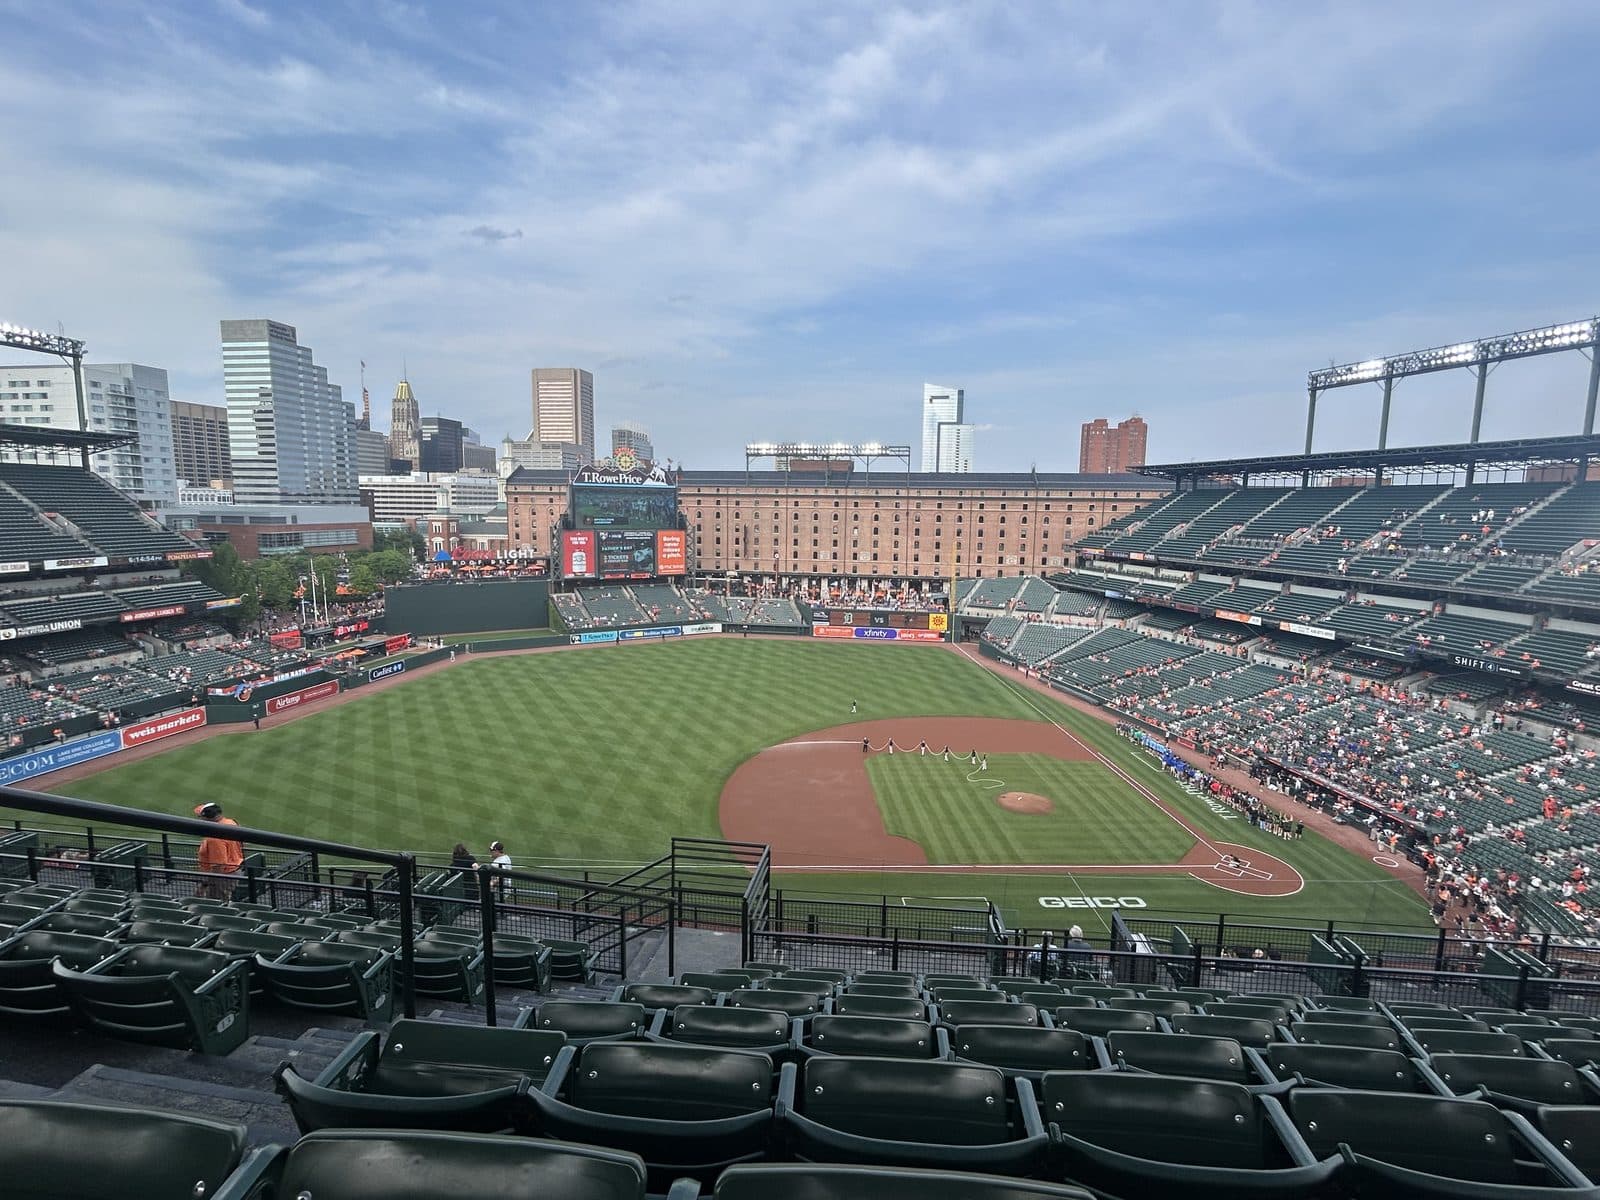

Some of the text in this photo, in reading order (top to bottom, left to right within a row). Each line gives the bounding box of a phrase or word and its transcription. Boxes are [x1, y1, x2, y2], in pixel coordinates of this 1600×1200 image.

[497, 549, 535, 559] LIGHT
[50, 620, 81, 630] UNION
[863, 629, 887, 637] xfinity
[1455, 656, 1485, 669] SHIFT
[1572, 680, 1594, 690] Great
[129, 713, 201, 741] weis markets
[1039, 896, 1147, 908] GEICO
